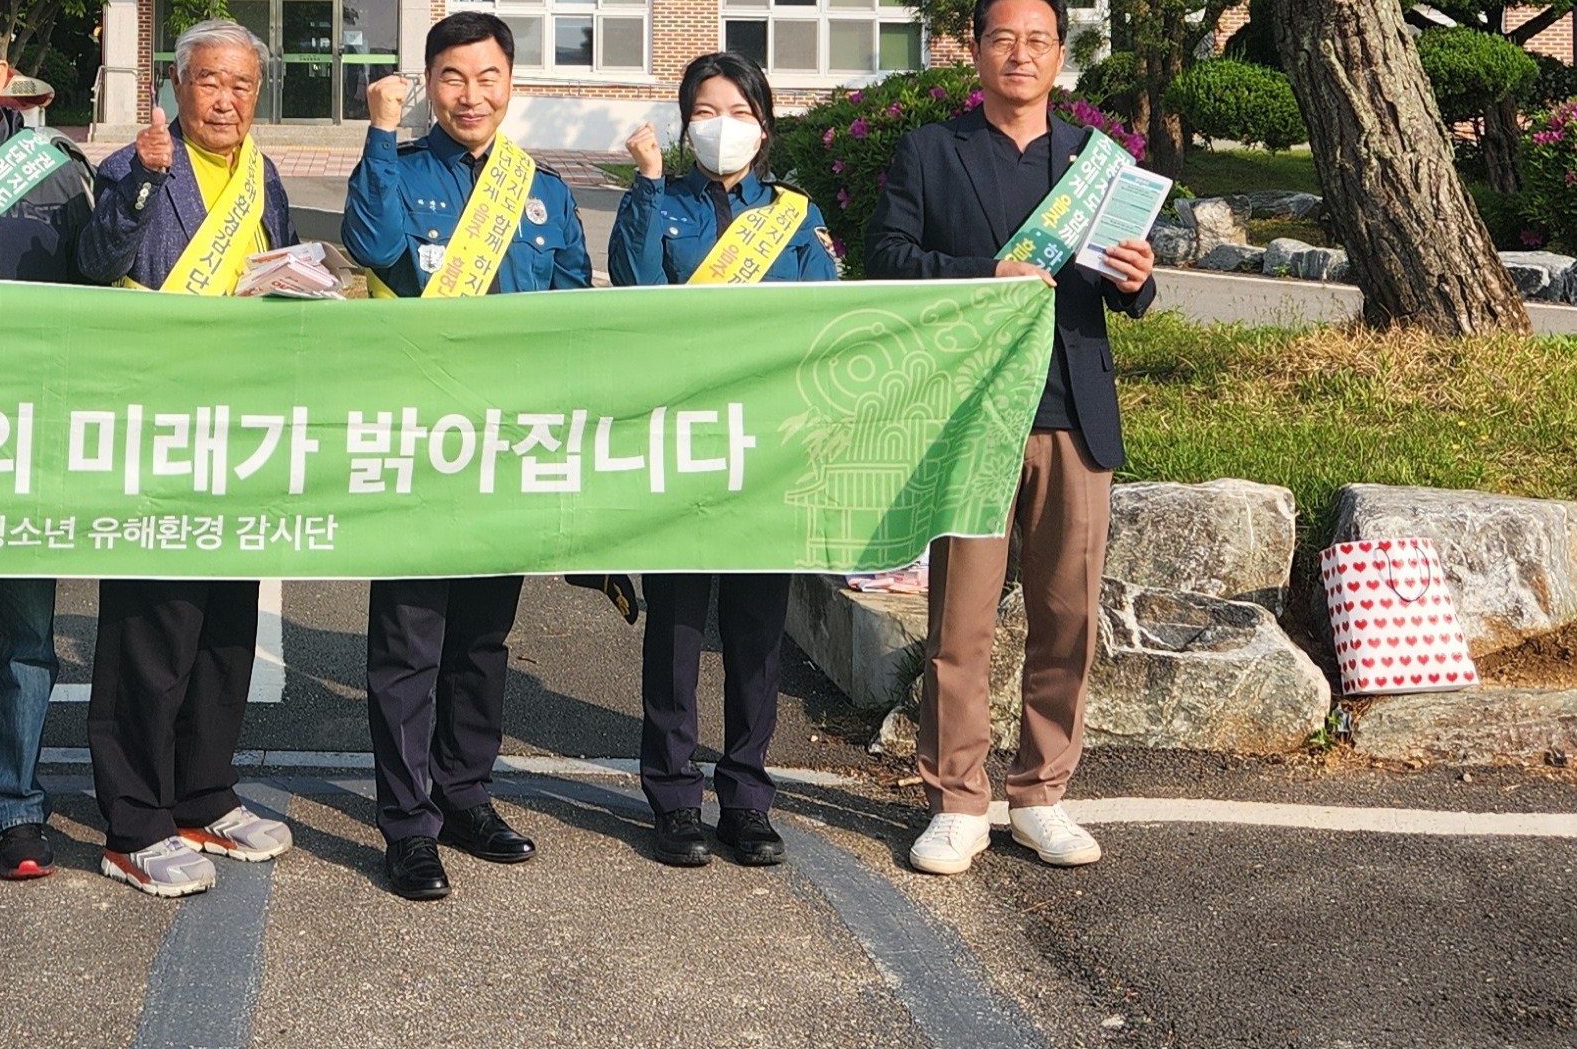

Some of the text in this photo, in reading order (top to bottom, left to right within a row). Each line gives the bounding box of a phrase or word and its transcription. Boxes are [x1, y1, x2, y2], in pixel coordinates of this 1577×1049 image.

[484, 214, 511, 255] 함께
[67, 404, 320, 496] 미래가
[345, 402, 758, 495] 밝아집니다
[87, 515, 226, 552] 유해환경
[236, 515, 341, 553] 감시단
